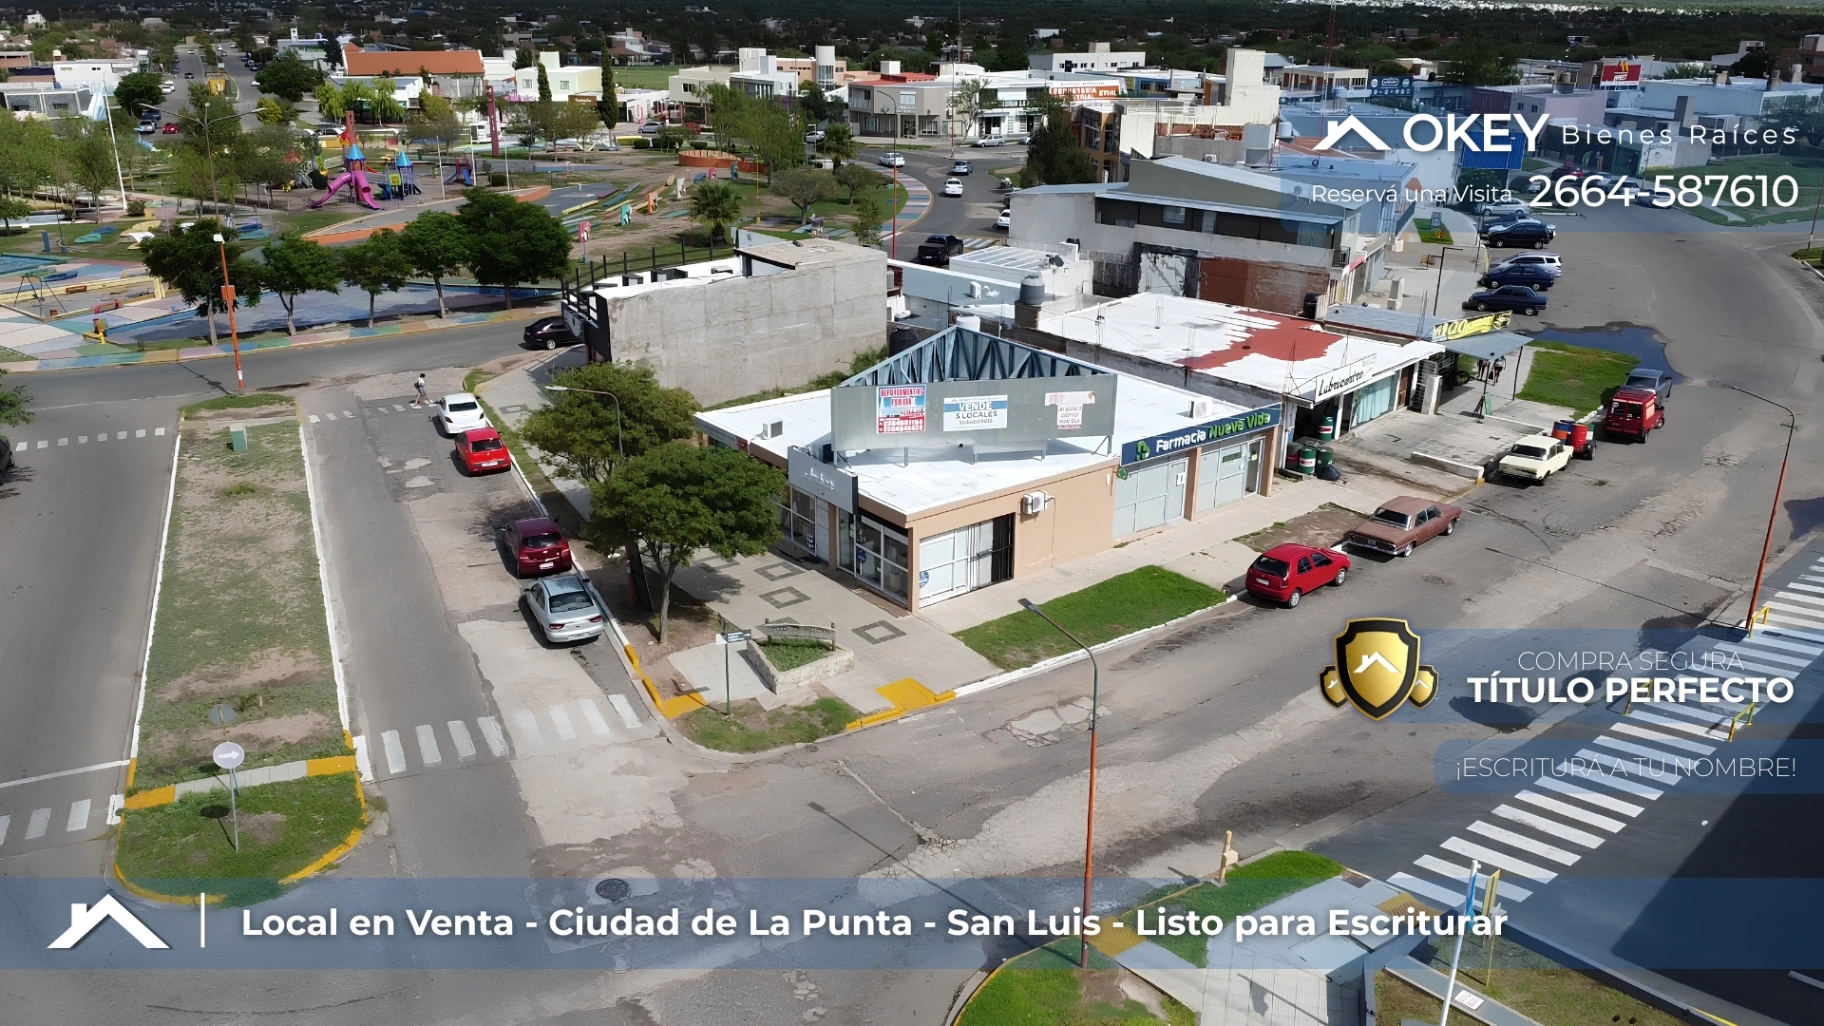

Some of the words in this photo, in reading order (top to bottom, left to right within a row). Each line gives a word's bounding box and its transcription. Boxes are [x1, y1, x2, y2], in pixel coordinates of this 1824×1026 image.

[958, 401, 992, 411] VENDE
[1155, 429, 1207, 453] Farmacia
[1208, 418, 1245, 439] Nueva
[1246, 411, 1271, 428] Vida
